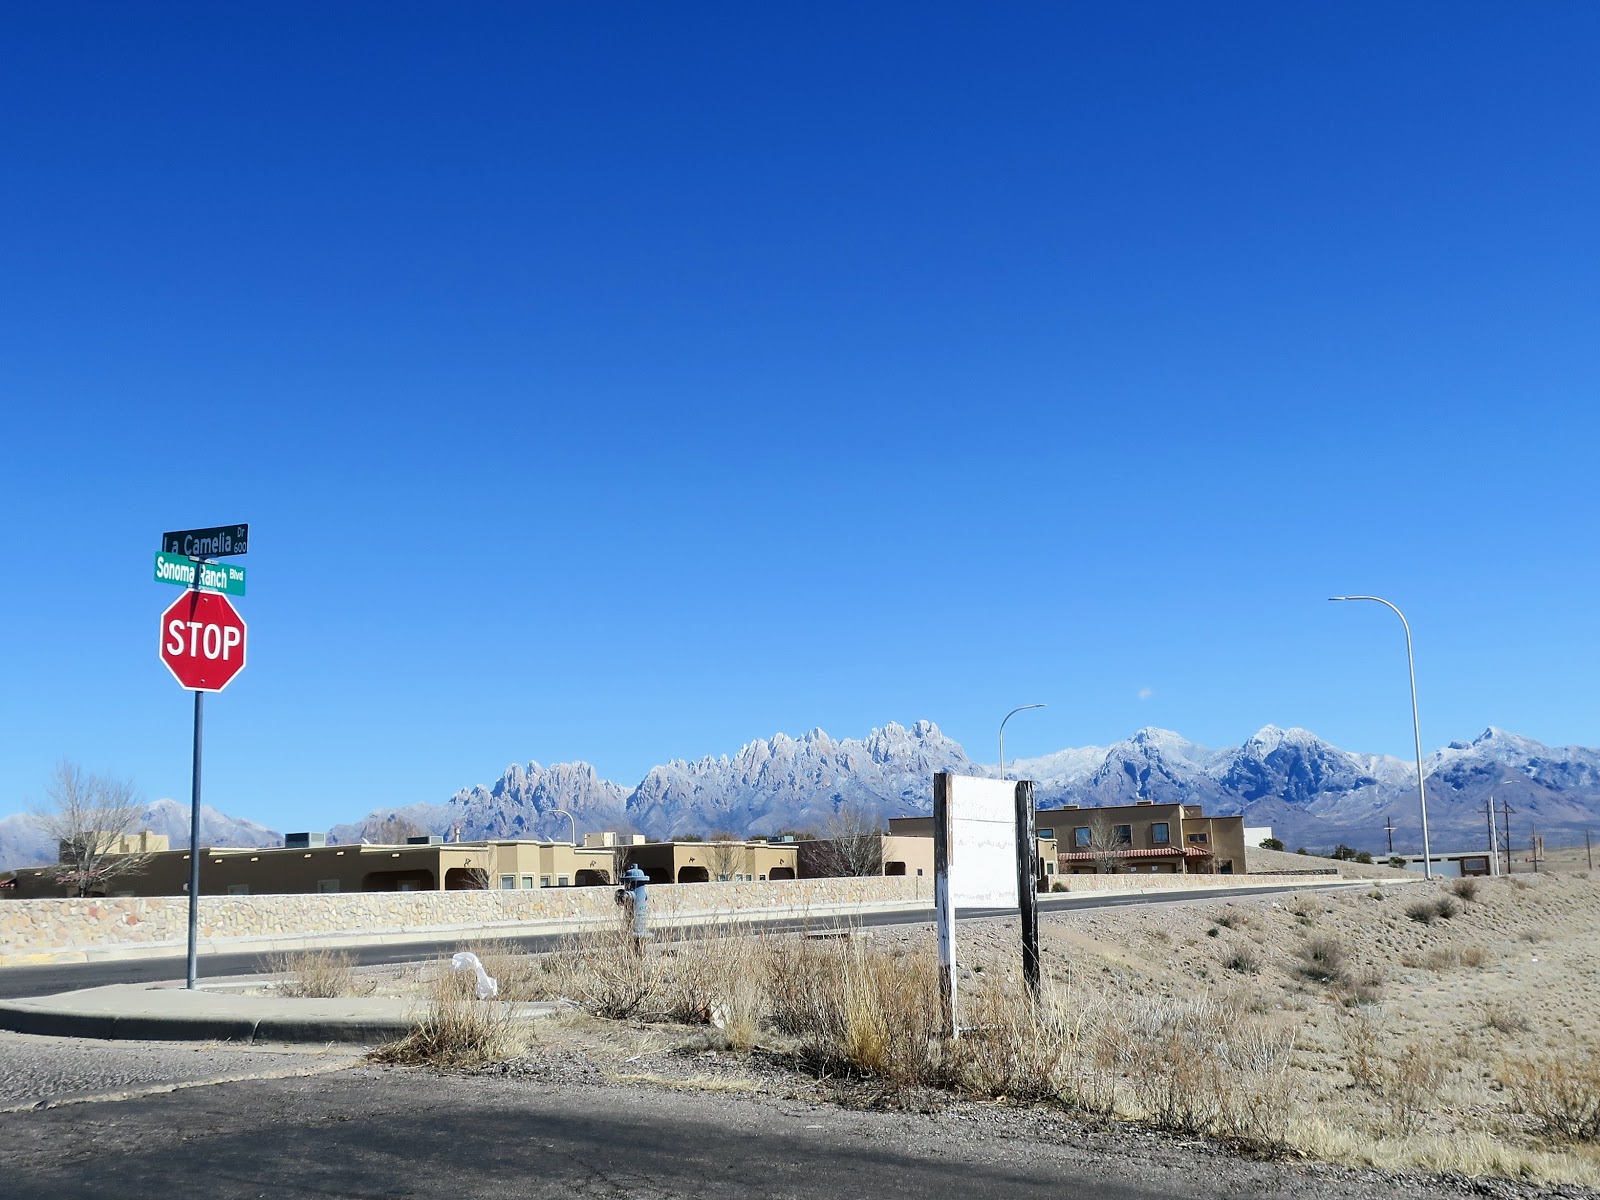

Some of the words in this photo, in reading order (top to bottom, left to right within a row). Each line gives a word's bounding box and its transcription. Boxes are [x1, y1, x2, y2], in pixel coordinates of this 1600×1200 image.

[184, 532, 231, 555] Camelia
[237, 527, 245, 537] Dr
[233, 542, 246, 554] 600
[156, 556, 195, 583] Sonoma
[199, 564, 227, 589] Ranch
[229, 568, 244, 581] Blvd
[166, 619, 241, 661] STOP
